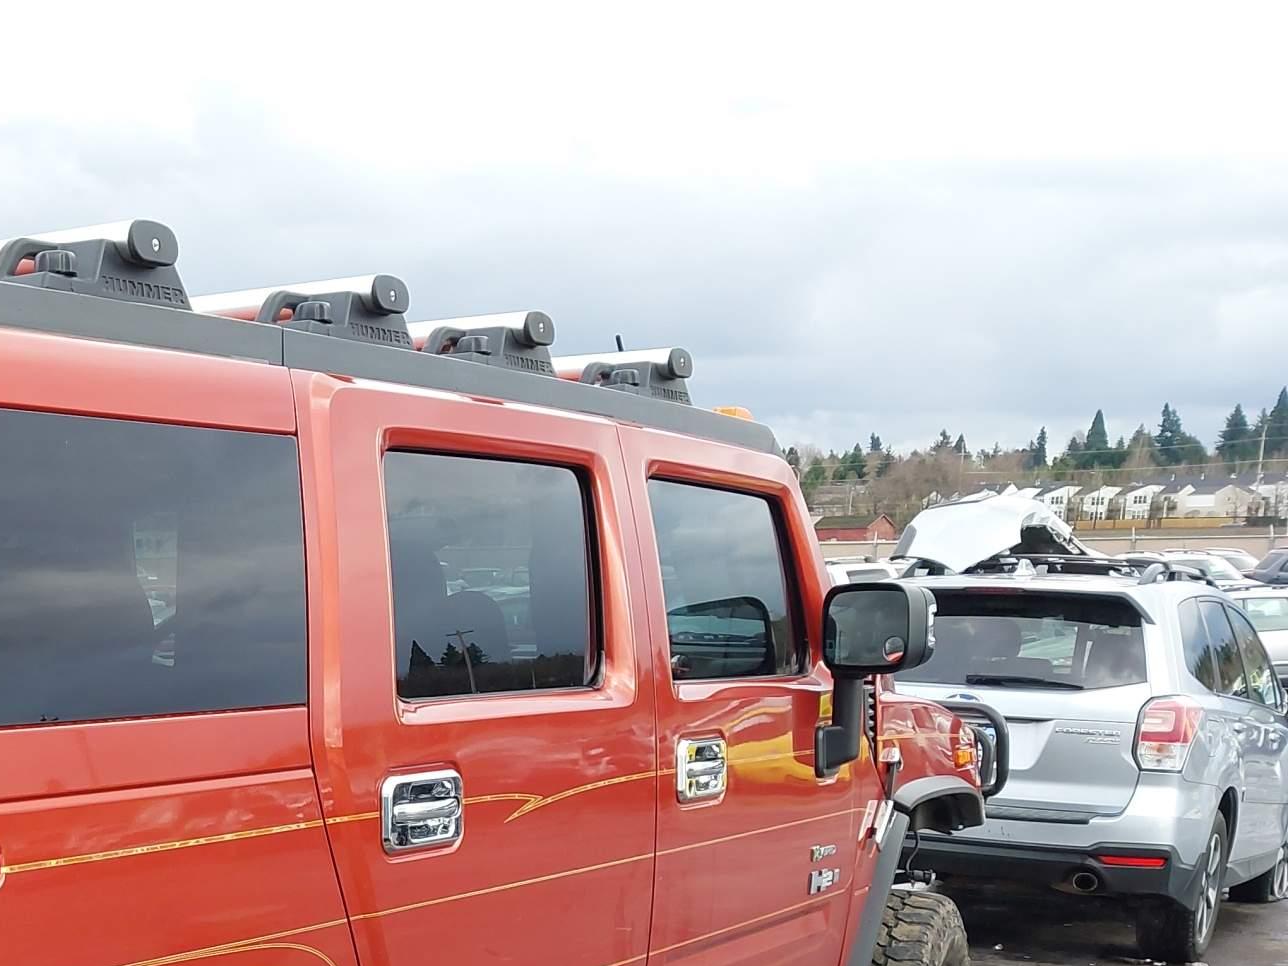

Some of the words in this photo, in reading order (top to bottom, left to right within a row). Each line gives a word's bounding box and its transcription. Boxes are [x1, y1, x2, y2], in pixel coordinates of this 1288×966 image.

[102, 275, 185, 304] HUMMER
[350, 322, 411, 345] HUMMER
[504, 353, 553, 374] HUMMER
